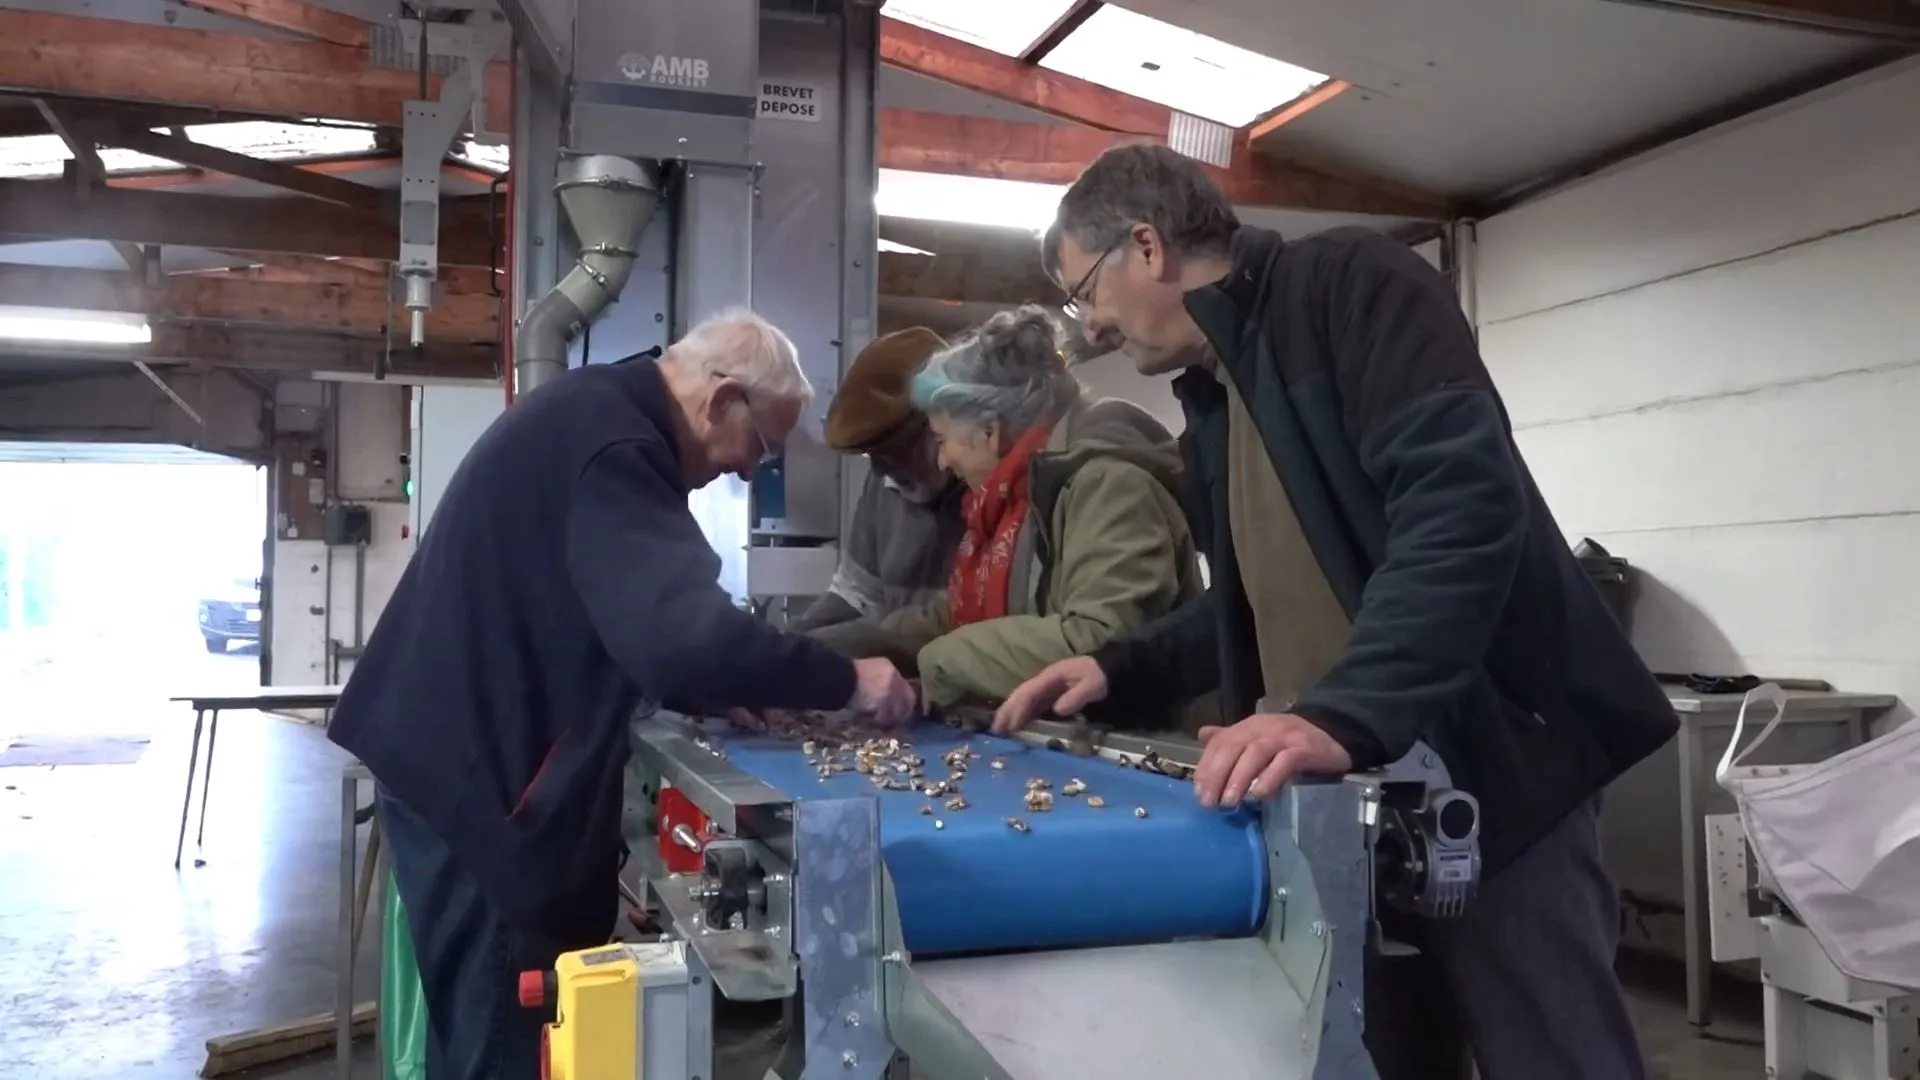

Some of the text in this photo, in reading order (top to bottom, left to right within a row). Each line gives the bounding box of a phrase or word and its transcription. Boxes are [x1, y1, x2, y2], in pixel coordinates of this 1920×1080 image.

[651, 54, 709, 79] AMB
[763, 84, 814, 99] BREVET
[761, 100, 815, 116] DEPOSE
